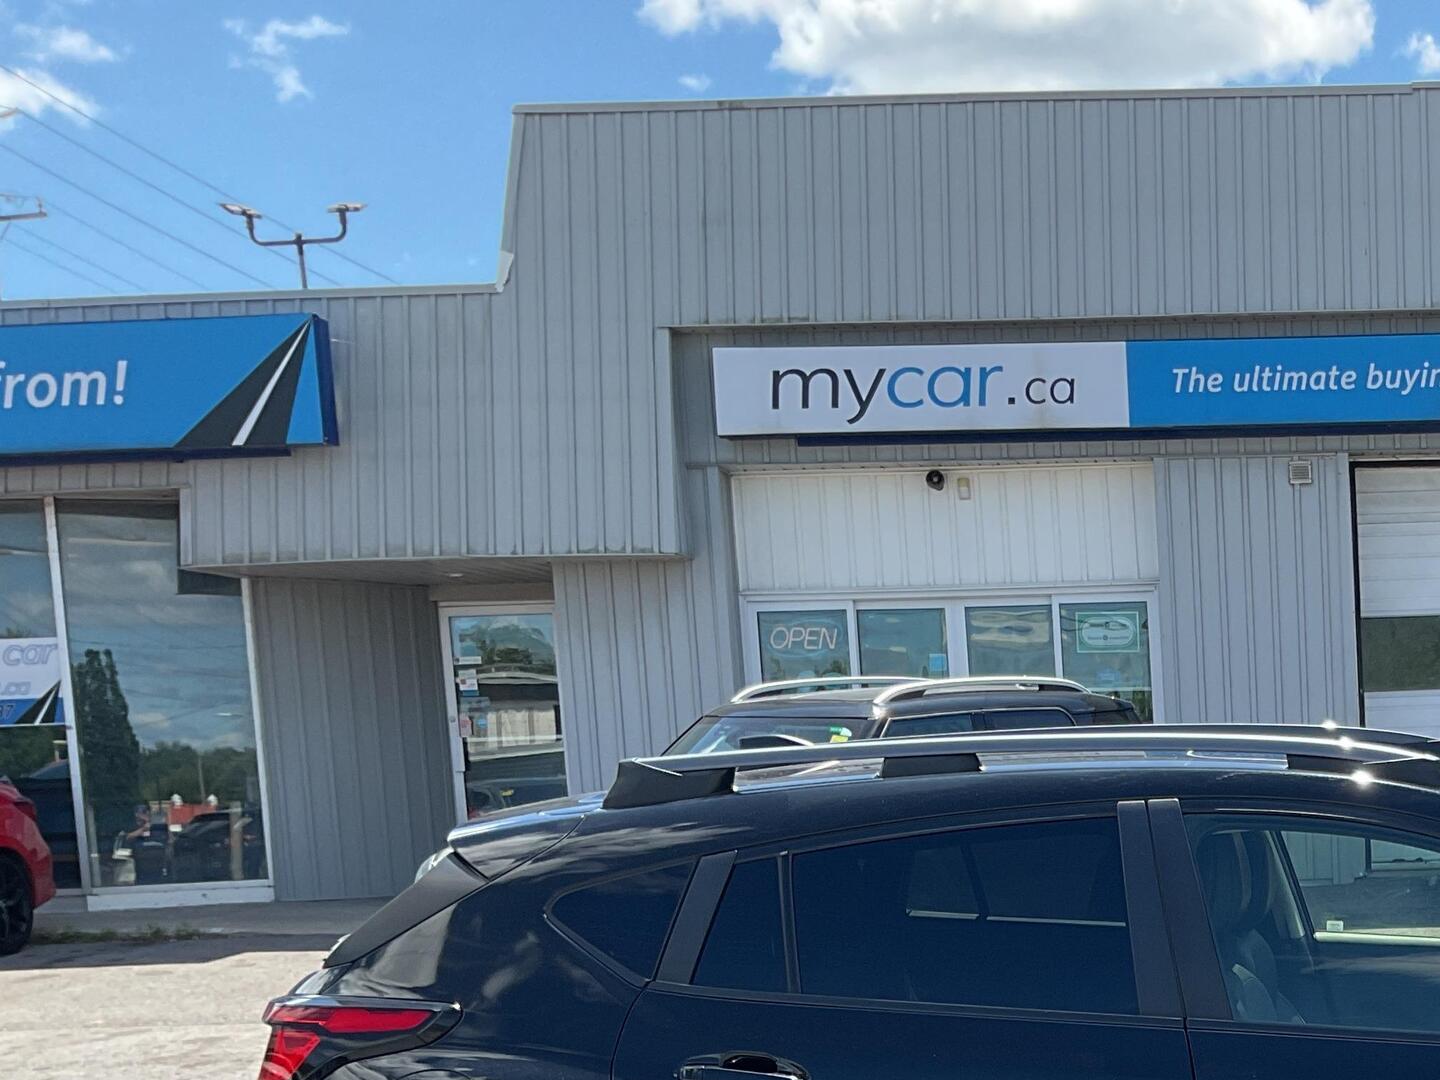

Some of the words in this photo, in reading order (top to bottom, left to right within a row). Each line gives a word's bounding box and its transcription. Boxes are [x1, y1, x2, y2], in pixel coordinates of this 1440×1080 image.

[0, 359, 128, 409] rom!
[771, 365, 1075, 424] mycar.ca
[1172, 366, 1223, 394] The
[1233, 364, 1357, 393] ultimate
[769, 626, 838, 650] OPEN
